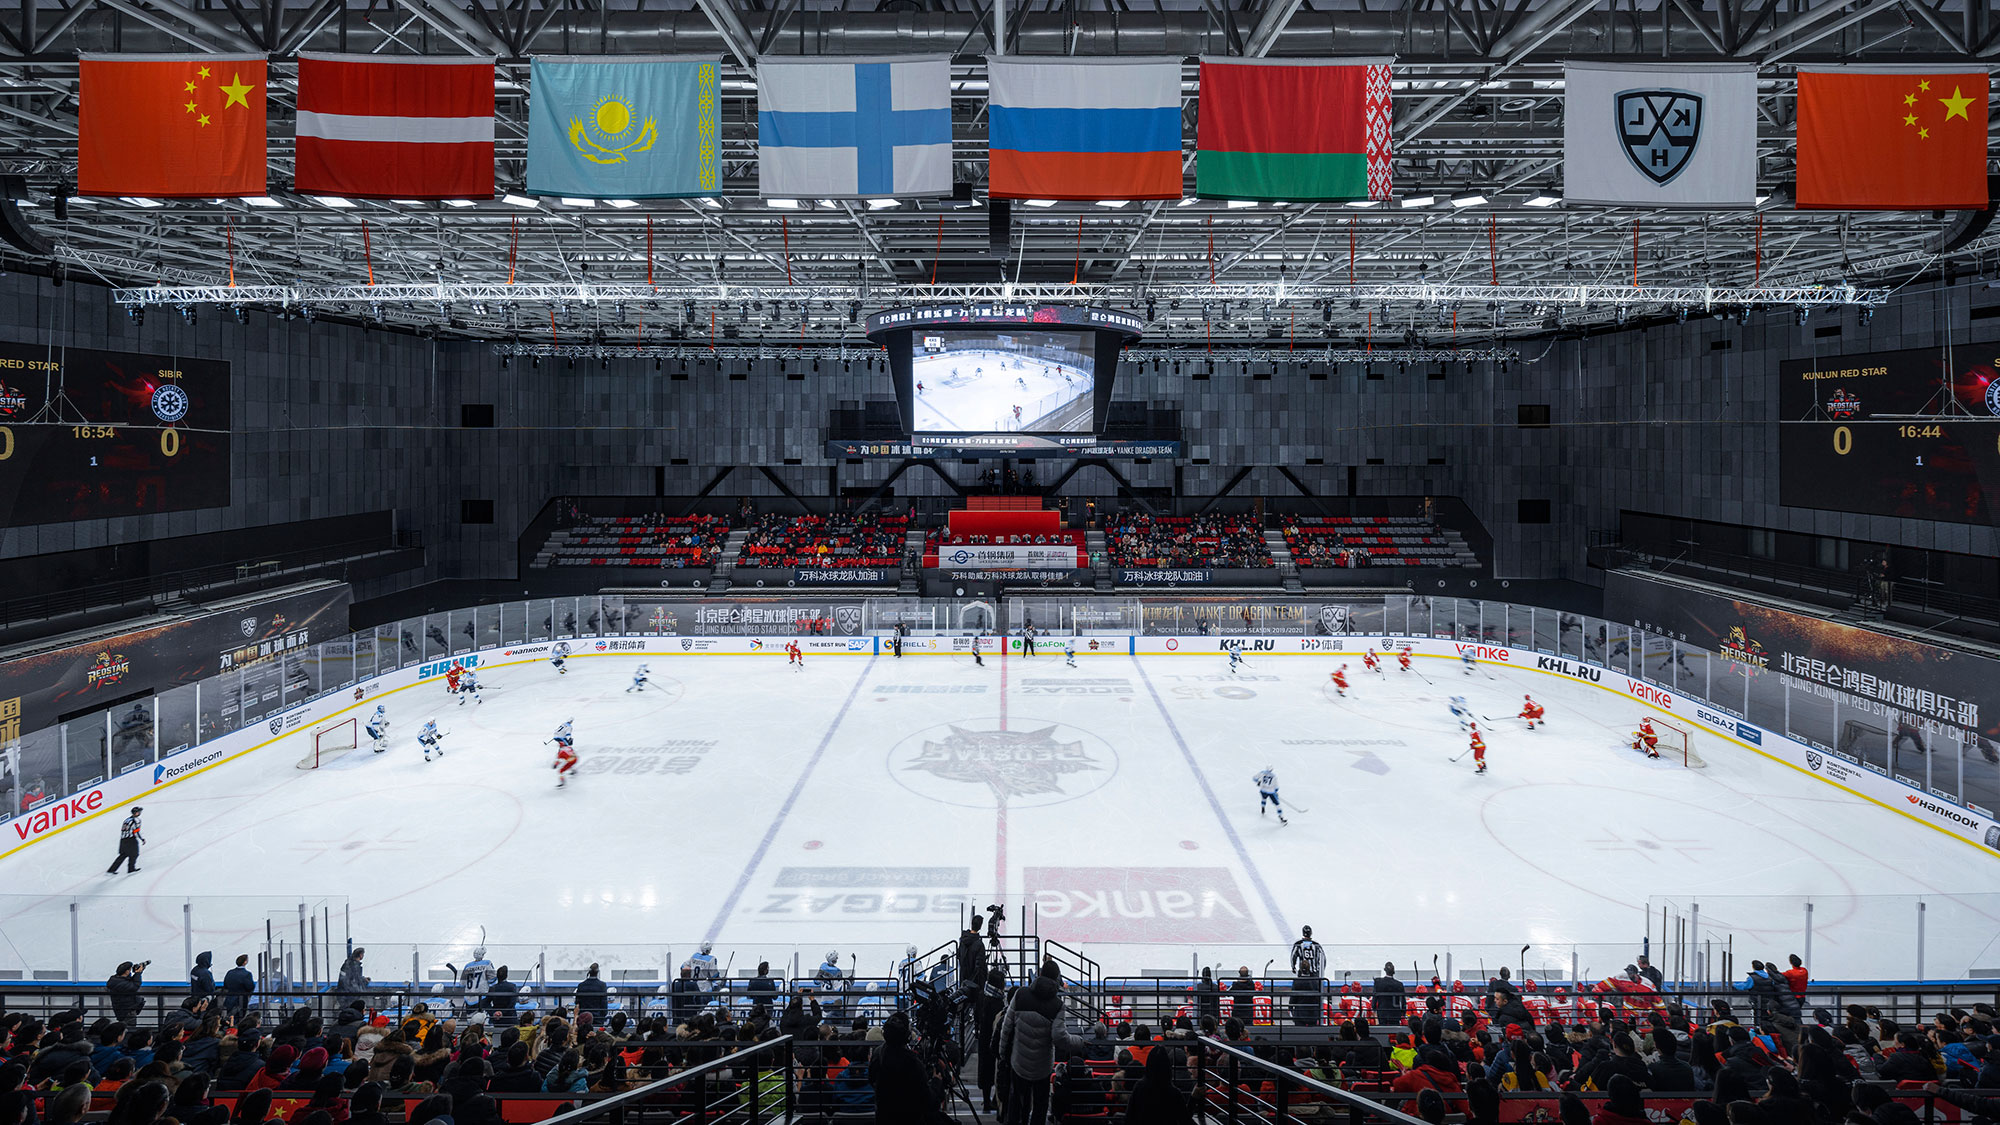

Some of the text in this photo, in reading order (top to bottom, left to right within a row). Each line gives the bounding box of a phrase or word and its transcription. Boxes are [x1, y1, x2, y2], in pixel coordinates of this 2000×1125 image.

[28, 361, 60, 372] STAR
[1802, 366, 1888, 380] KUNLUN RED STAR
[158, 370, 183, 379] SIBR
[72, 426, 115, 439] 16:54
[1899, 425, 1941, 438] 16:44
[161, 428, 180, 457] 0
[1833, 426, 1852, 455] 0
[90, 456, 98, 466] 1
[1915, 456, 1923, 466] 1
[1193, 605, 1226, 620] VANKE
[1275, 605, 1303, 620] TEAM
[761, 625, 777, 634] STAR
[609, 640, 646, 650] 腾讯体育
[848, 639, 865, 650] SAP
[87, 661, 129, 684] REDSTAR
[1537, 656, 1601, 682] KHL.RU
[1627, 679, 1672, 709] vanke
[1780, 650, 1979, 728] 北京昆仑鸿星冰球俱乐部
[1697, 709, 1735, 732] SOGAZ
[1851, 695, 1870, 712] RED
[1902, 711, 1944, 736] HOCKEY
[166, 750, 223, 779] Rostelecom
[1932, 789, 1956, 802] KHL.RU
[14, 790, 104, 841] vanke
[1035, 889, 1248, 919] vanke
[1303, 950, 1314, 958] 61
[466, 971, 484, 990] 67
